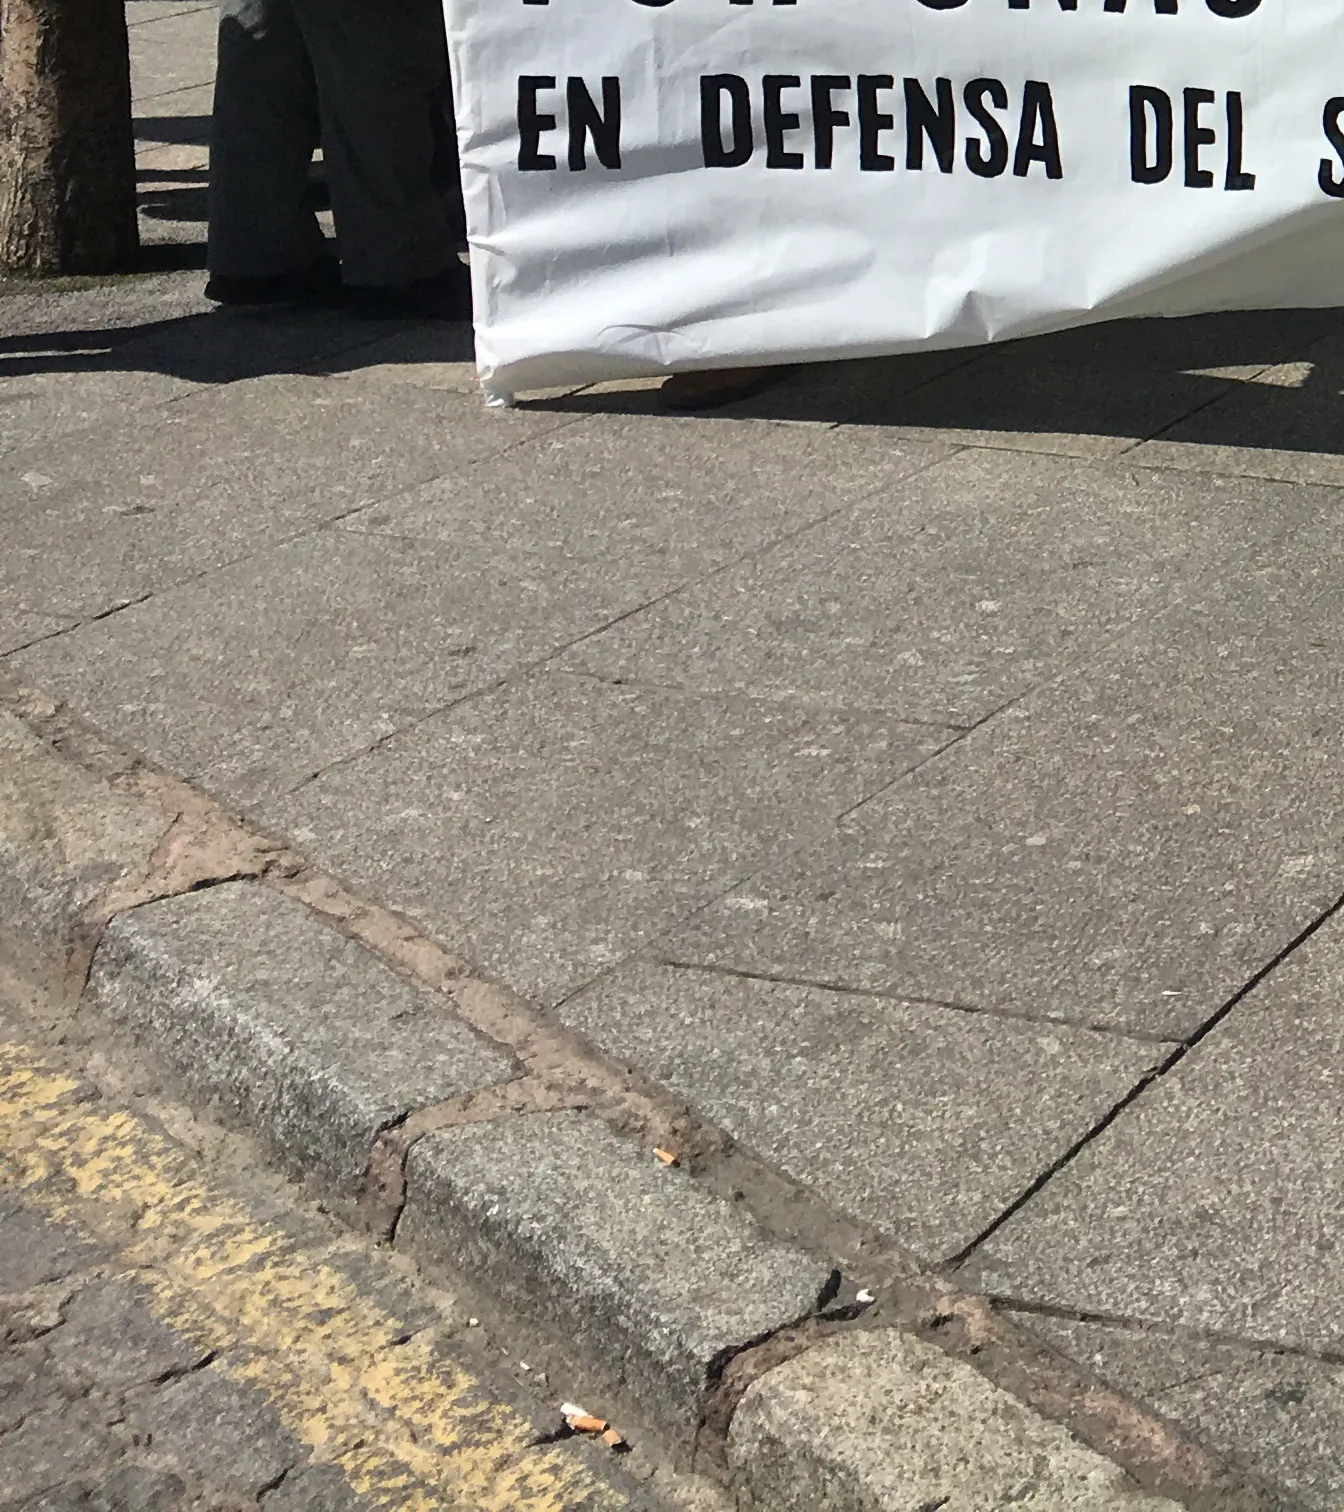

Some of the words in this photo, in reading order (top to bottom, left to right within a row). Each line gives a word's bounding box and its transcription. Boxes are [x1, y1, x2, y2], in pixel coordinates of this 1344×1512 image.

[516, 75, 622, 172] EN
[700, 73, 1064, 181] DEFENSA
[1128, 84, 1256, 191] DEL
